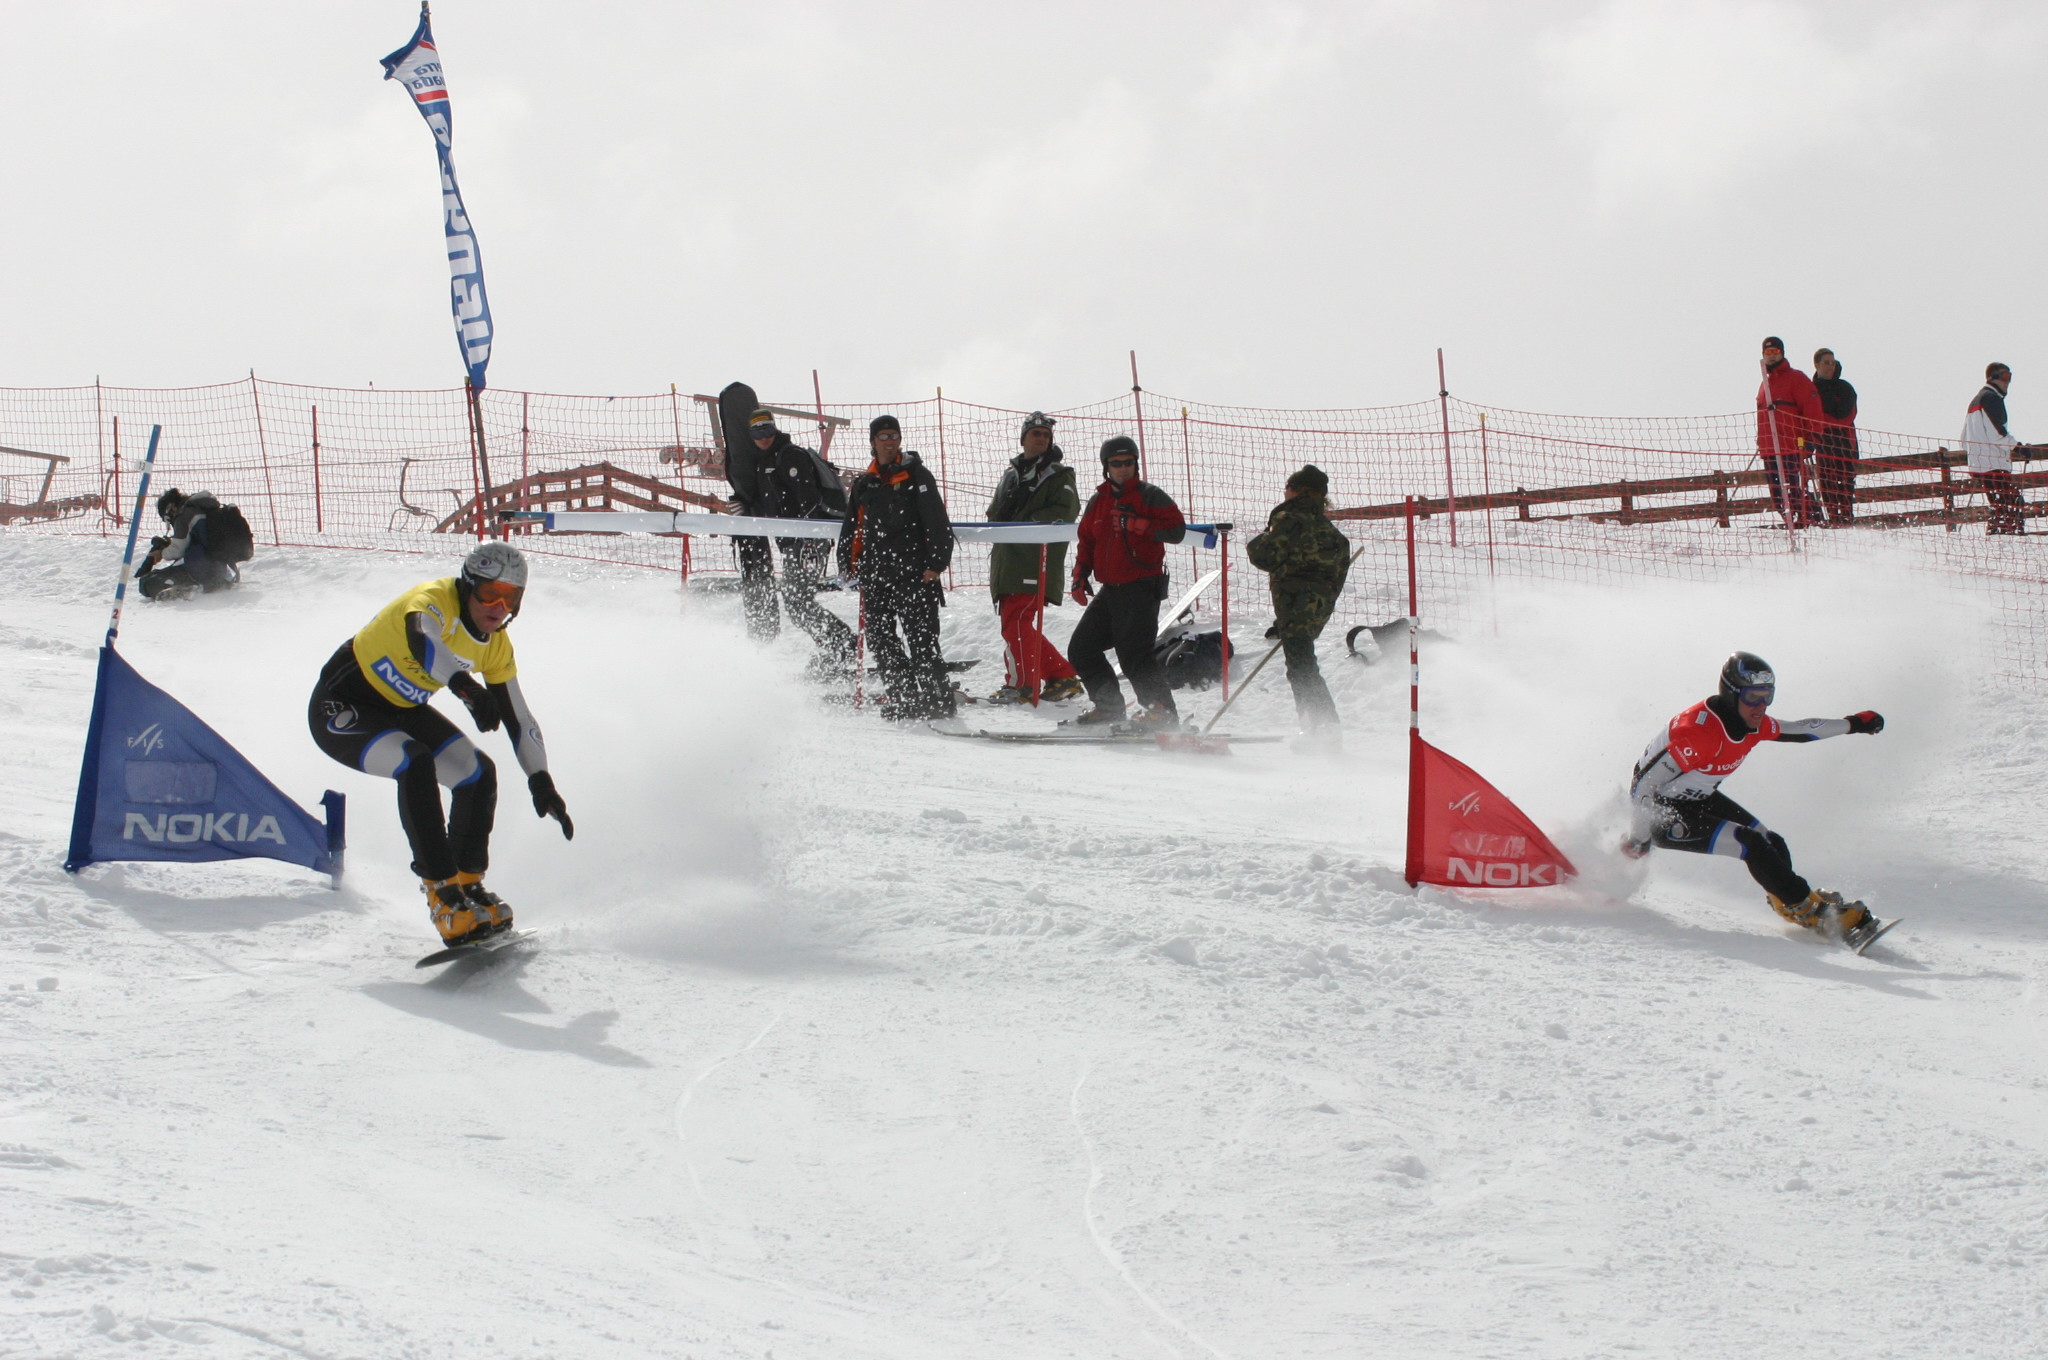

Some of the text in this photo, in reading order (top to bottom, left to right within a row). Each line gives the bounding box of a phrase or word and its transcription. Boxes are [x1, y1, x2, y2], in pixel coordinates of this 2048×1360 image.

[112, 609, 119, 619] 2
[122, 812, 287, 845] NOKIA
[1446, 857, 1566, 886] NOKI
